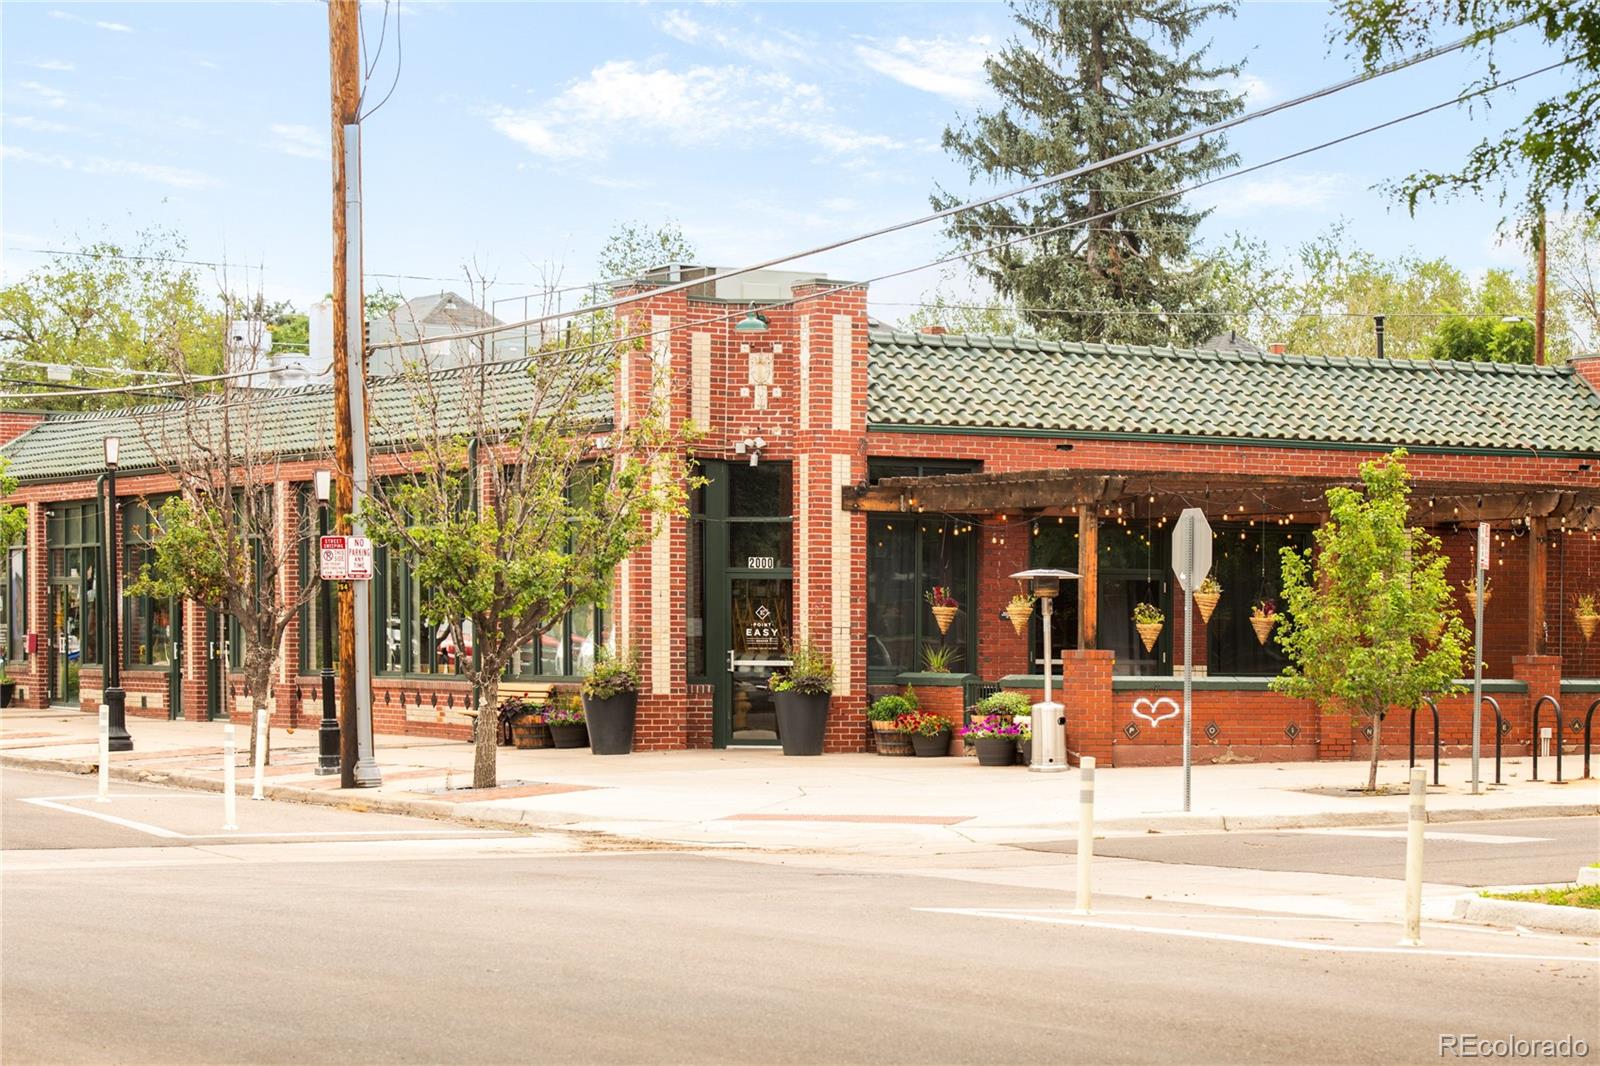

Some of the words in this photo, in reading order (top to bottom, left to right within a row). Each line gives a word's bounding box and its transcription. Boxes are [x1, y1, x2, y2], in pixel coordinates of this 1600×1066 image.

[354, 538, 364, 547] NO
[349, 548, 370, 556] PARKING
[749, 557, 773, 568] 2000
[746, 628, 778, 636] EASY
